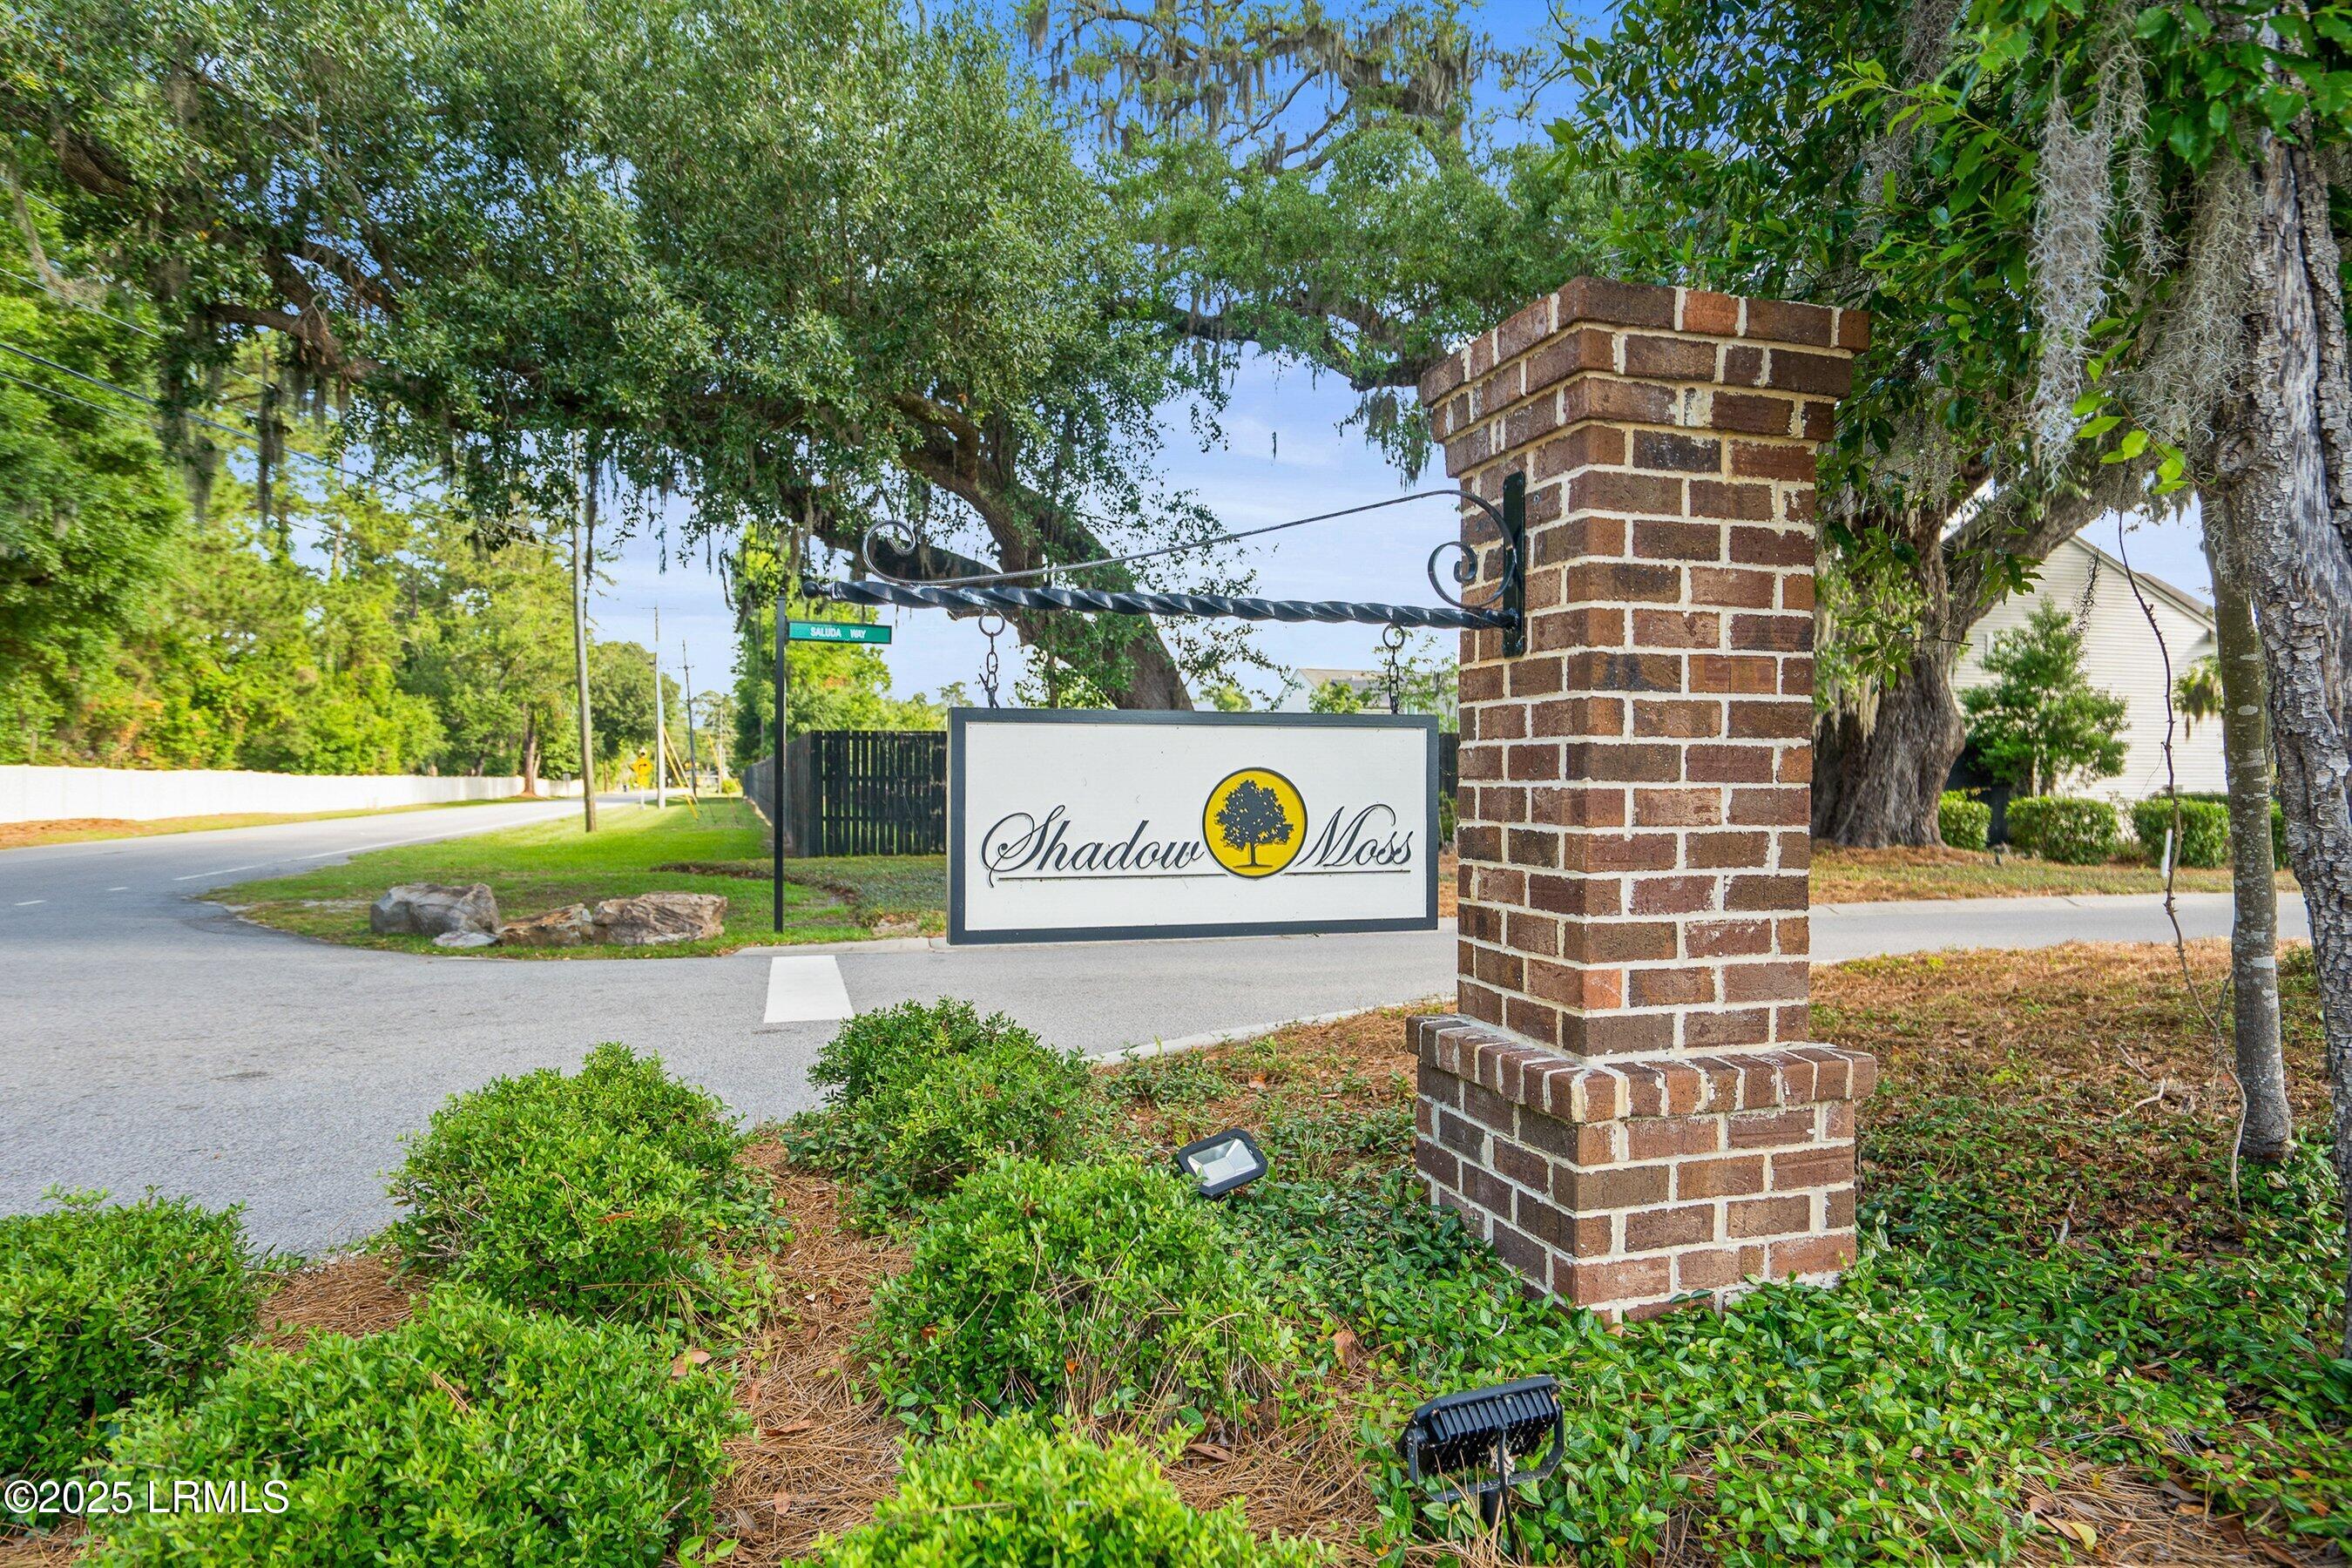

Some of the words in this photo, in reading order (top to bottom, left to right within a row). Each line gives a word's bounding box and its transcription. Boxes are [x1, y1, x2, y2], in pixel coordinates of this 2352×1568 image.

[809, 626, 842, 638] SALUDA
[849, 629, 867, 639] WAY
[981, 804, 1205, 888] Shadow
[1297, 803, 1413, 868] Moss
